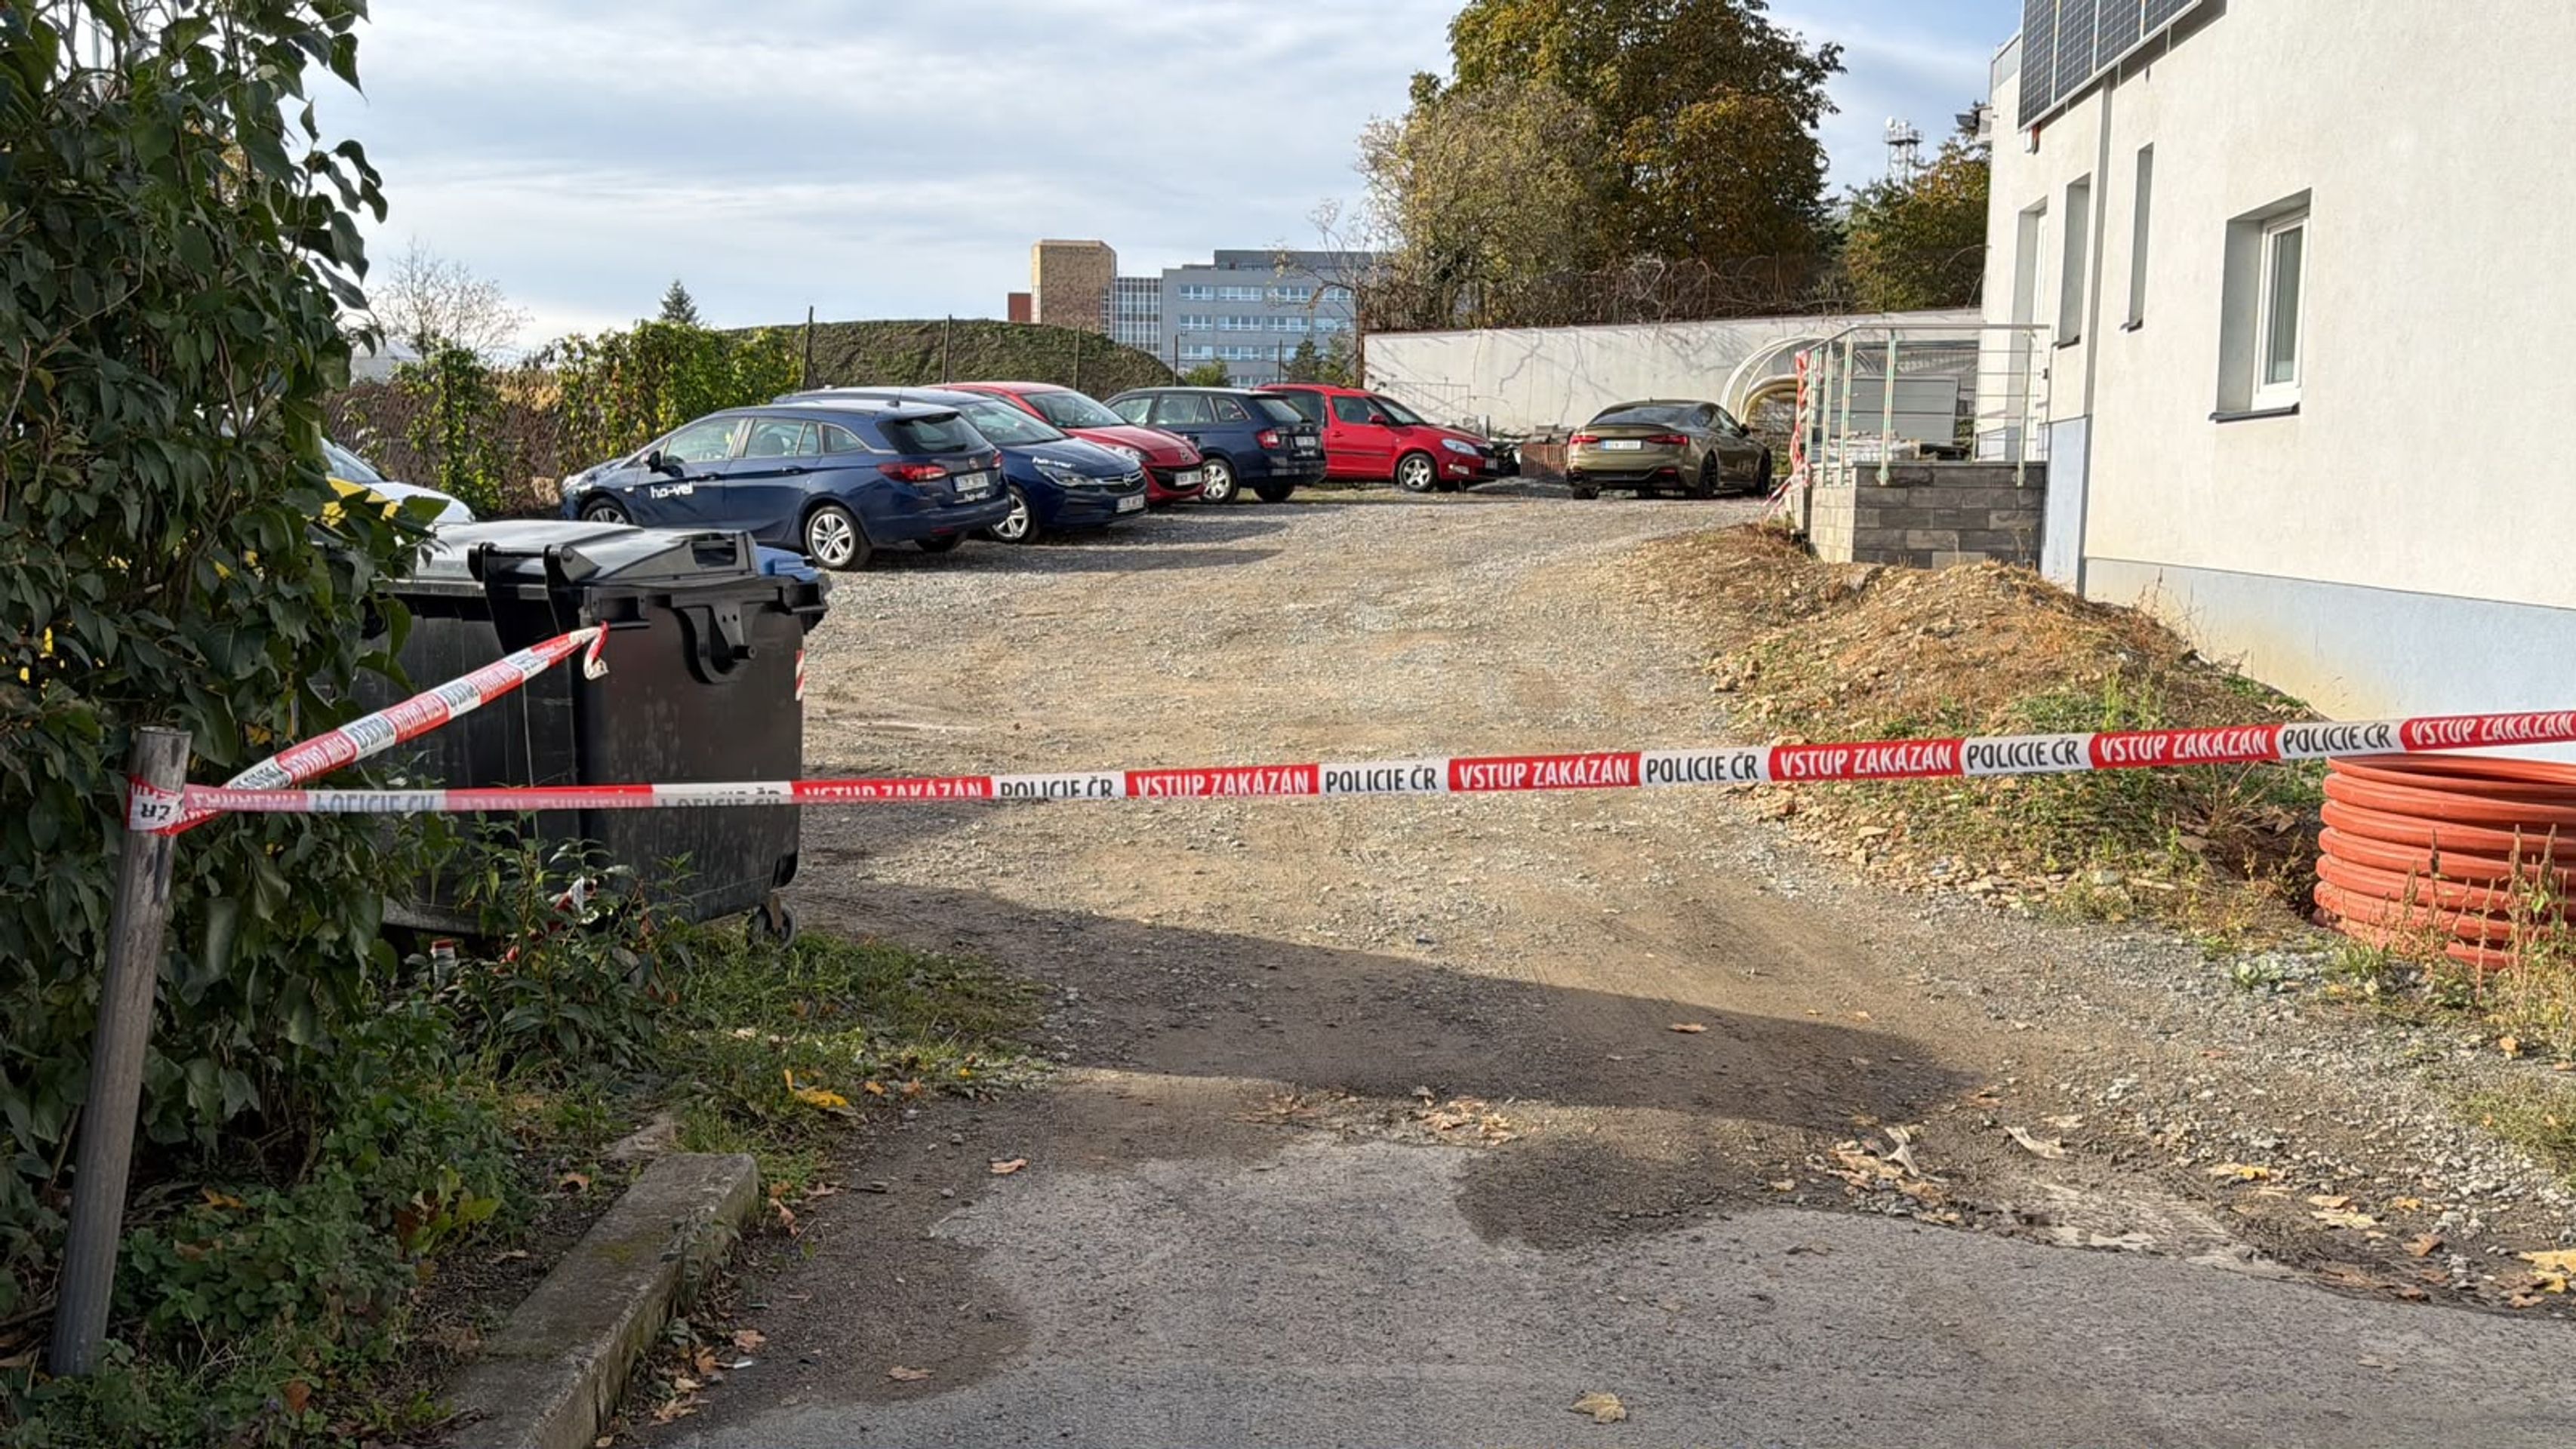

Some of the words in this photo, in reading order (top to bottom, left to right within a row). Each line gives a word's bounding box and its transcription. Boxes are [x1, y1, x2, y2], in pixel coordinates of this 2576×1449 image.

[1136, 774, 1205, 795] VSTUP
[1210, 767, 1309, 795] ZAKÁZÁN
[1326, 769, 1405, 792] POLICIE
[1411, 764, 1438, 790] ČR
[1458, 762, 1525, 788] VSTUP
[1532, 755, 1630, 786] ZAKÁZÁN
[1646, 755, 1725, 783] POLICIE
[1731, 752, 1759, 780] ČR
[1780, 749, 1848, 777] VSTUP
[1853, 743, 1953, 774] ZAKÁZÁN
[1968, 742, 2048, 769] POLICIE
[2051, 737, 2081, 765] ČR
[2100, 733, 2166, 763] VSTUP
[2283, 725, 2362, 754] POLICIE
[2411, 718, 2477, 746] VSTUP
